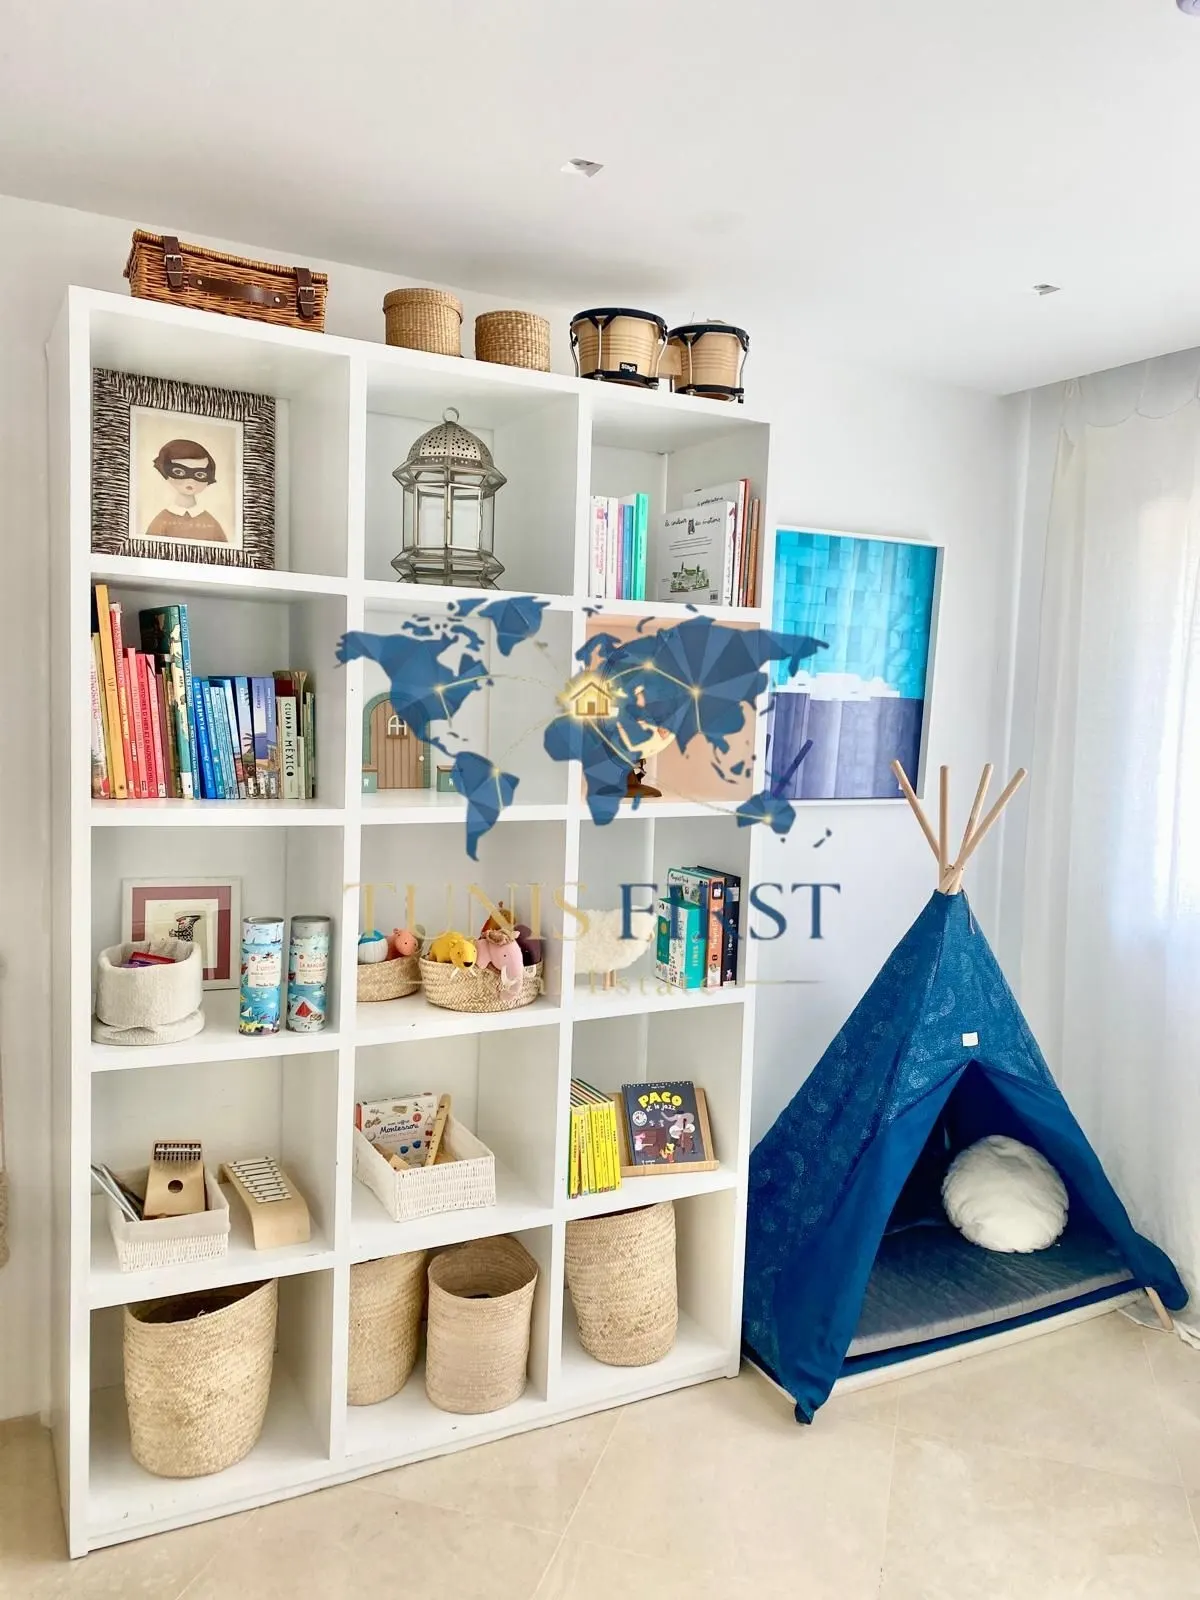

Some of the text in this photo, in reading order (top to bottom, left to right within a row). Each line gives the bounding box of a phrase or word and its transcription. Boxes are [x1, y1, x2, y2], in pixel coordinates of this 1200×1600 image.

[140, 681, 148, 711] HISTOIRES
[284, 702, 292, 729] CIUDAD
[284, 740, 296, 777] MÉXICO
[638, 1091, 682, 1107] PACO
[661, 1102, 676, 1111] jazz
[380, 1123, 419, 1134] Montessori
